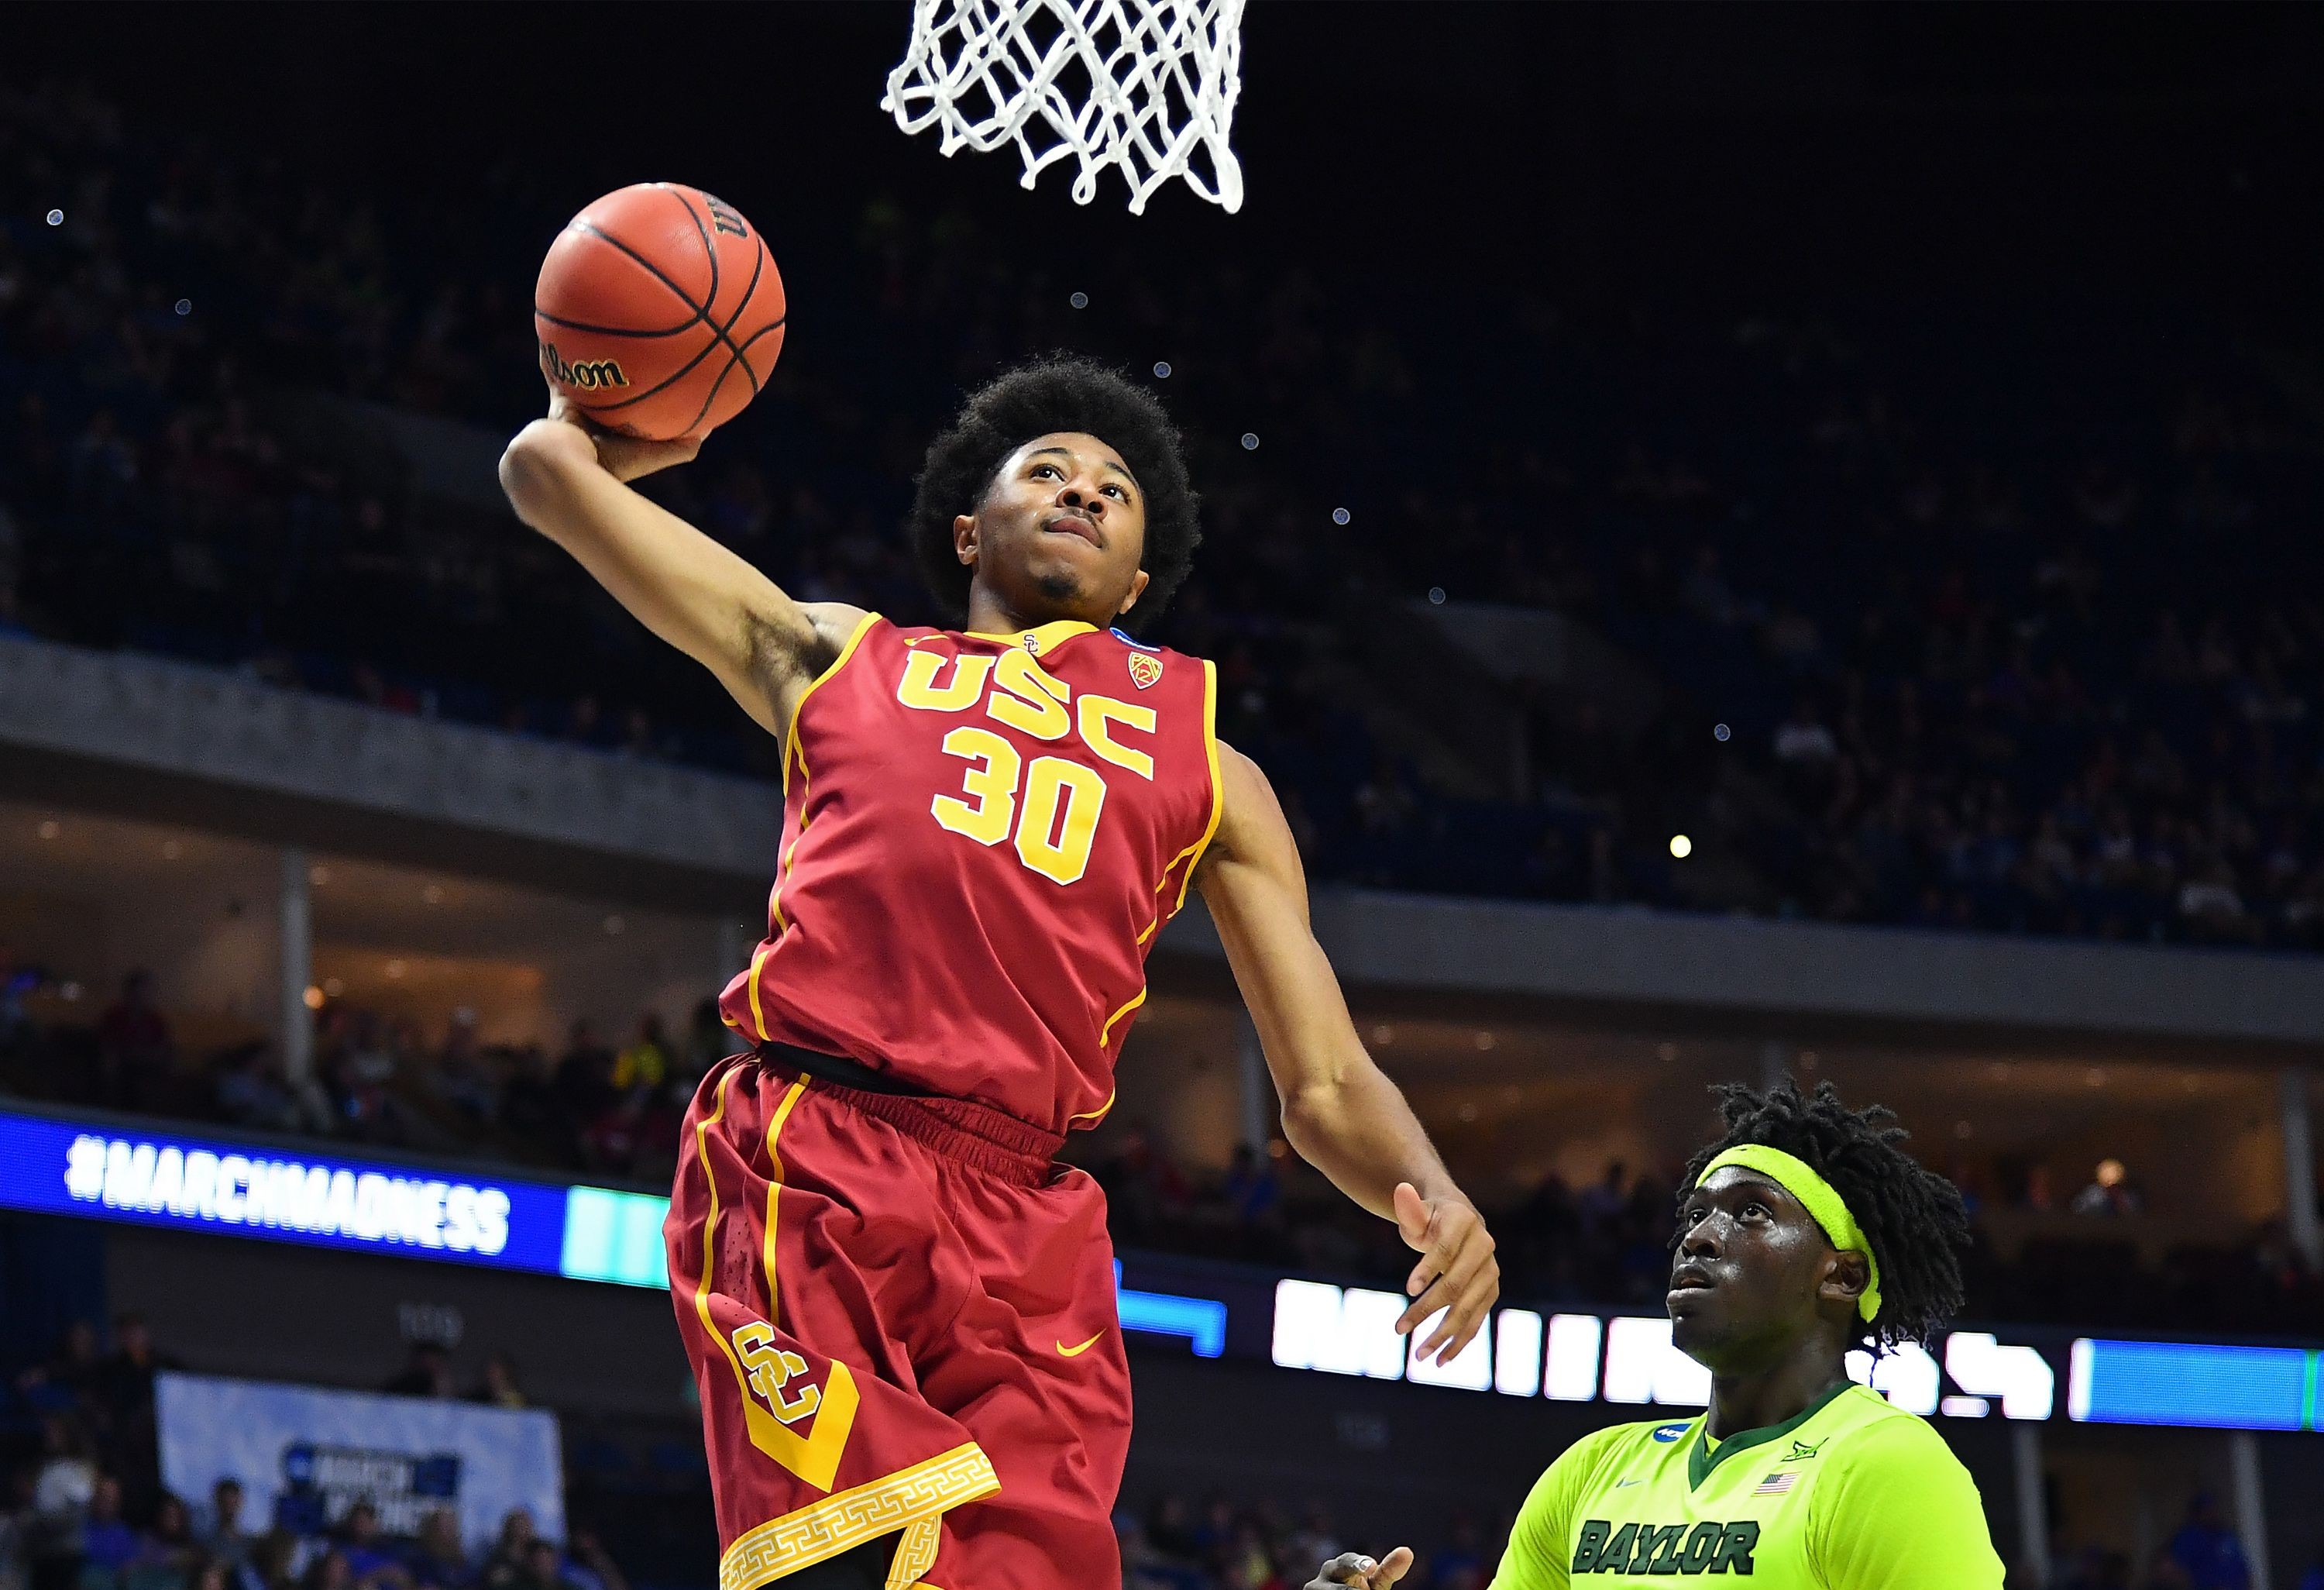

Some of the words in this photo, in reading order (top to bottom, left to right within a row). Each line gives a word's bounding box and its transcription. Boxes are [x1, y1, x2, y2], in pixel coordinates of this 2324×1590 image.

[541, 342, 630, 391] lson
[1131, 656, 1161, 679] PAC
[1136, 668, 1152, 684] 12
[896, 647, 1157, 782] USC
[930, 725, 1108, 886] 30
[64, 1134, 510, 1255] #MARCHMADNESS
[732, 1320, 822, 1425] SC
[1572, 1519, 1761, 1575] BAYLOR
